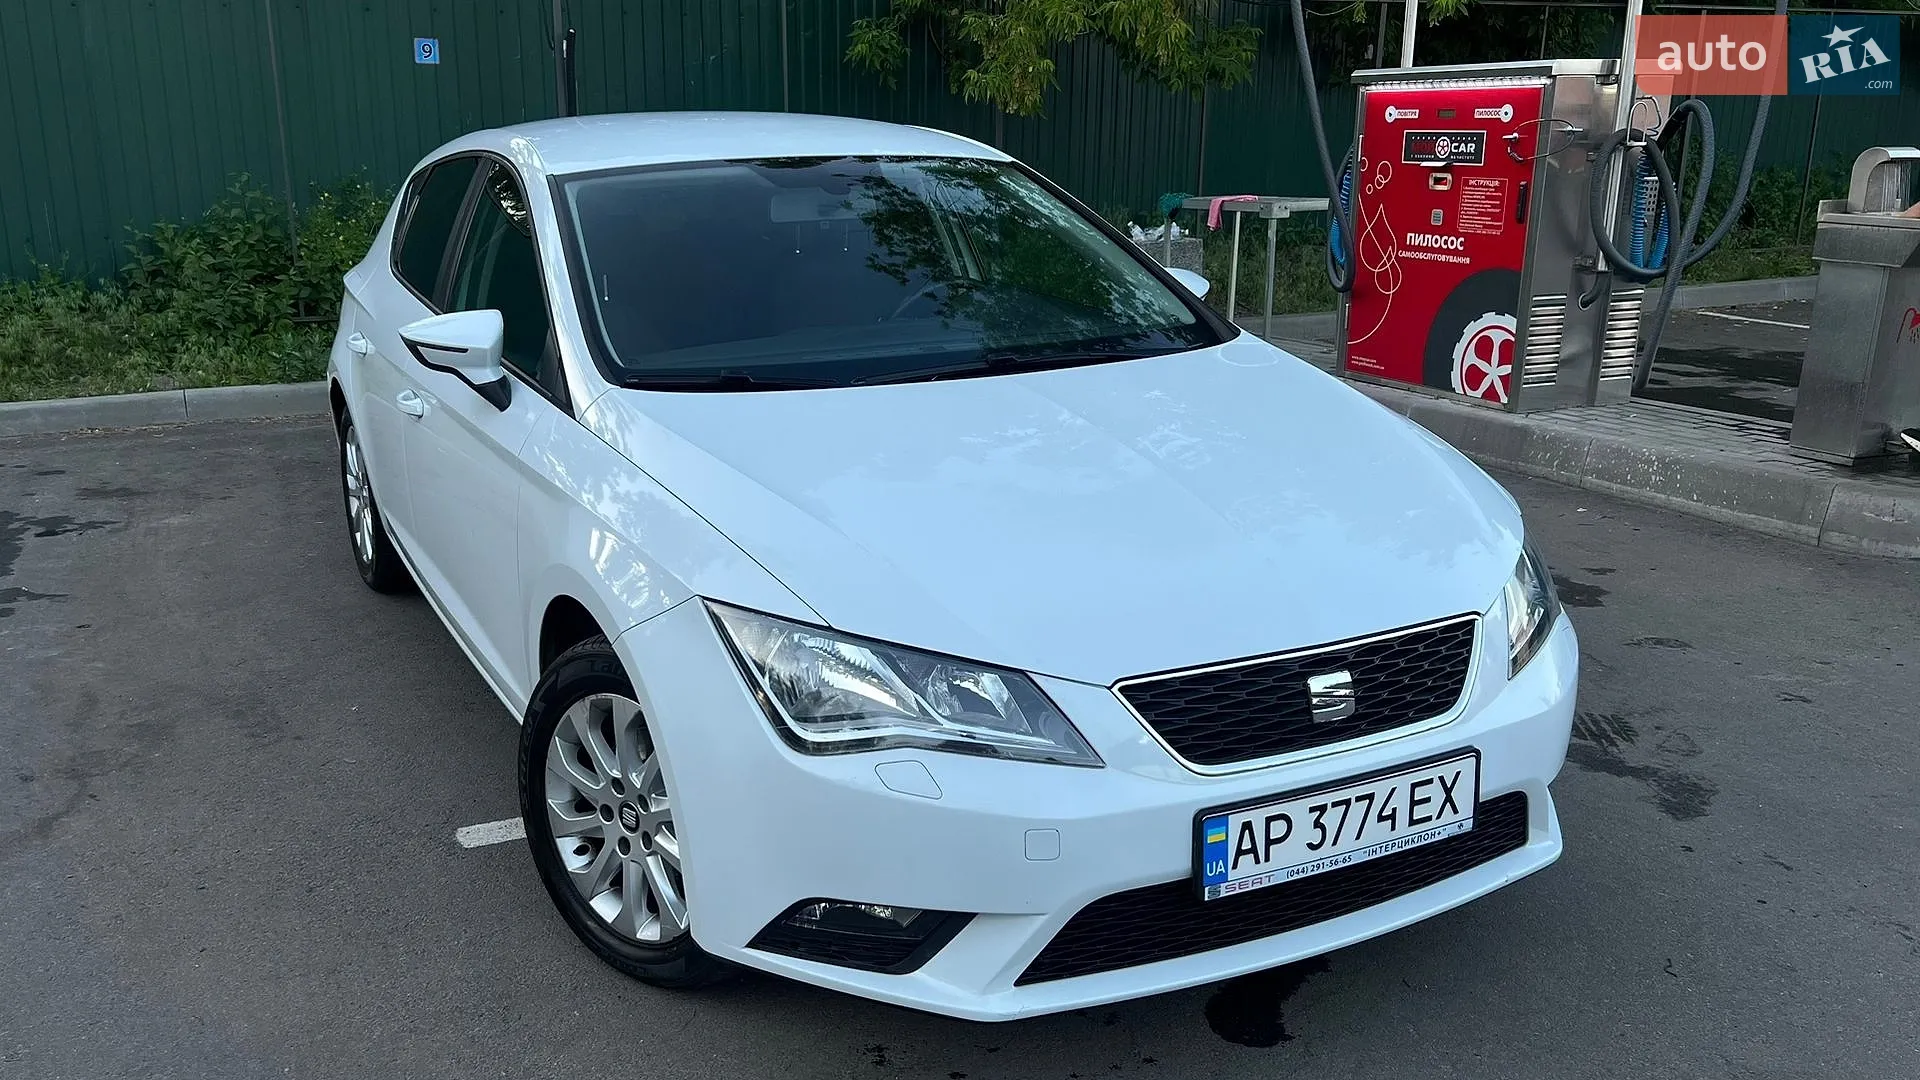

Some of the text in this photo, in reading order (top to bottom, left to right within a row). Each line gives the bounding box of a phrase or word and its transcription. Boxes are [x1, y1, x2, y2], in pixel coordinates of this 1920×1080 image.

[421, 43, 433, 59] 9
[1451, 143, 1475, 153] CAR
[1406, 232, 1465, 251] ПИЛОСОС
[1398, 250, 1470, 264] САМООБСЛУГОВУВАННЯ
[1231, 770, 1462, 870] AP 3774 EX
[1206, 859, 1226, 877] UA
[1224, 874, 1276, 893] SEAT
[1286, 865, 1309, 879] (044)
[1310, 854, 1353, 873] 291-56-65
